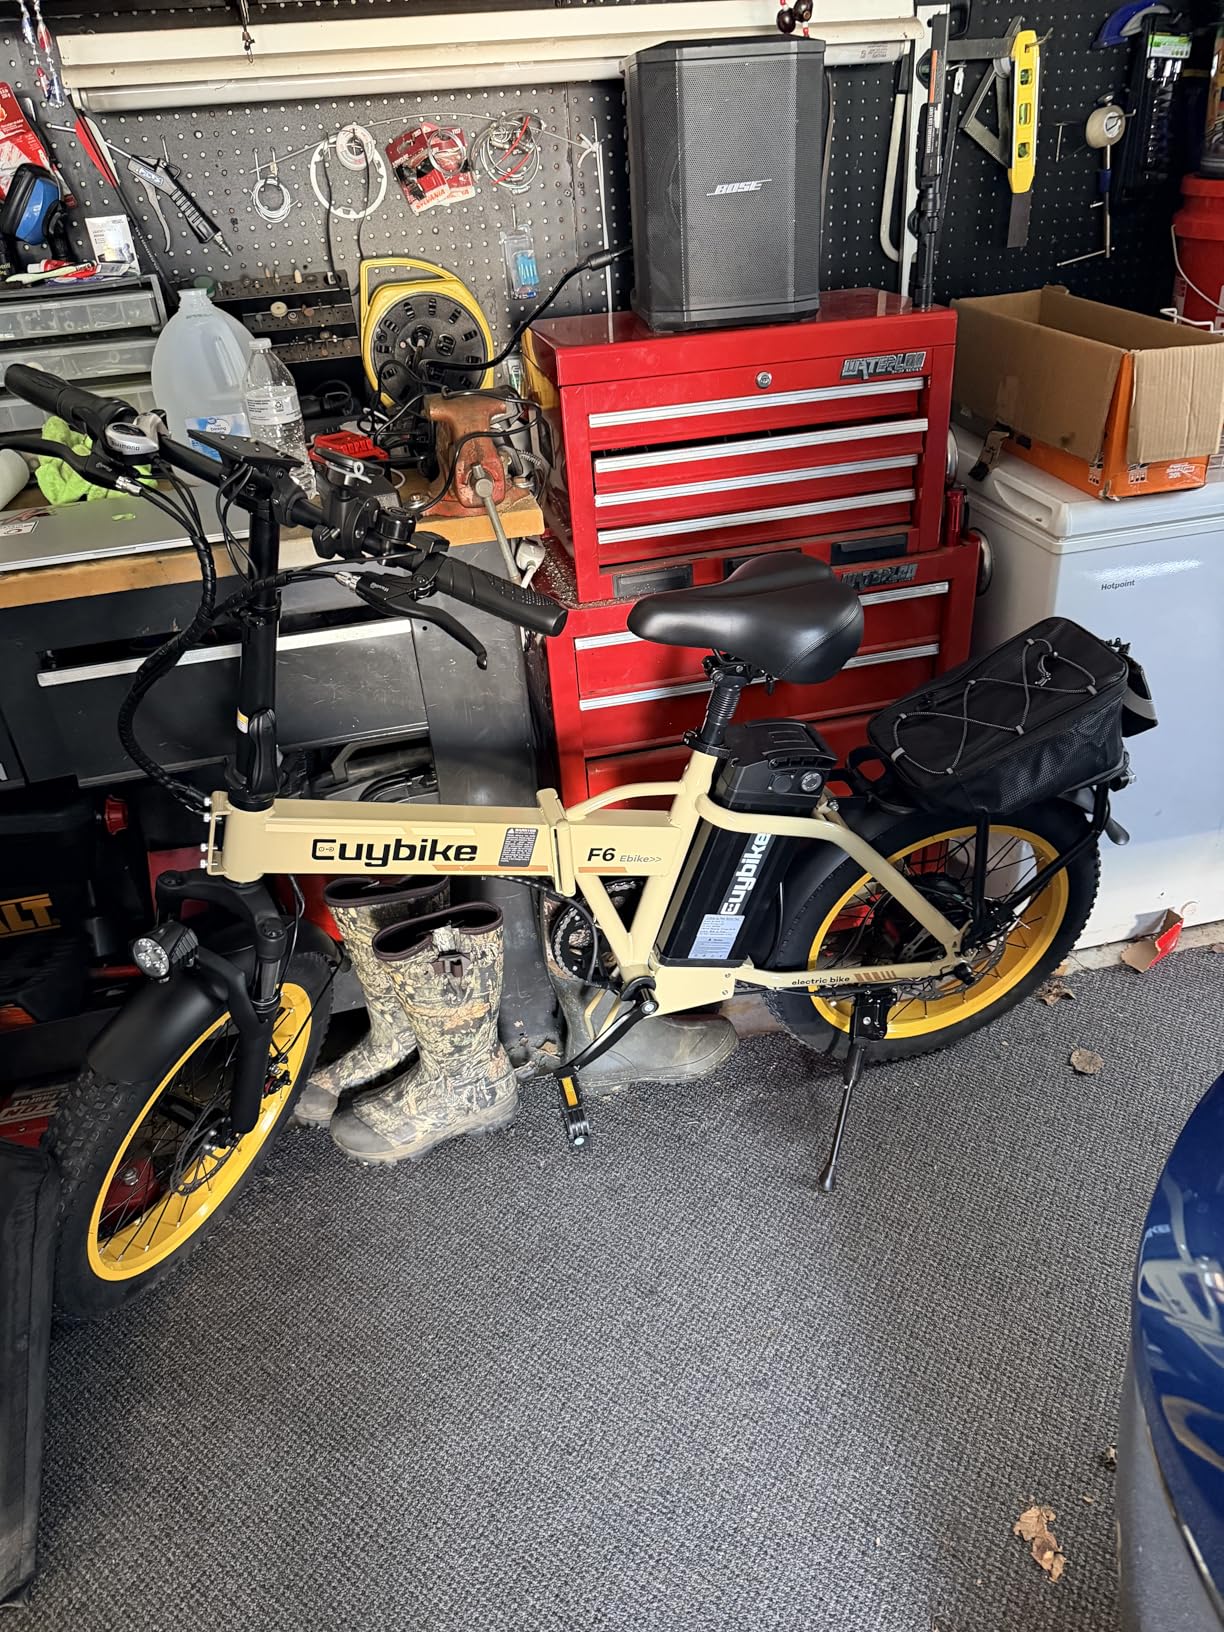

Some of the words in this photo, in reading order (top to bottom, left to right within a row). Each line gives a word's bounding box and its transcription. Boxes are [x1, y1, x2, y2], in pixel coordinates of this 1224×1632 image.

[707, 179, 771, 196] BOSE
[415, 188, 446, 209] SYLVANIA
[1101, 580, 1135, 590] Hotpoint
[587, 847, 616, 862] F6
[0, 898, 53, 933] LT
[791, 977, 828, 986] electric
[830, 975, 850, 983] bike
